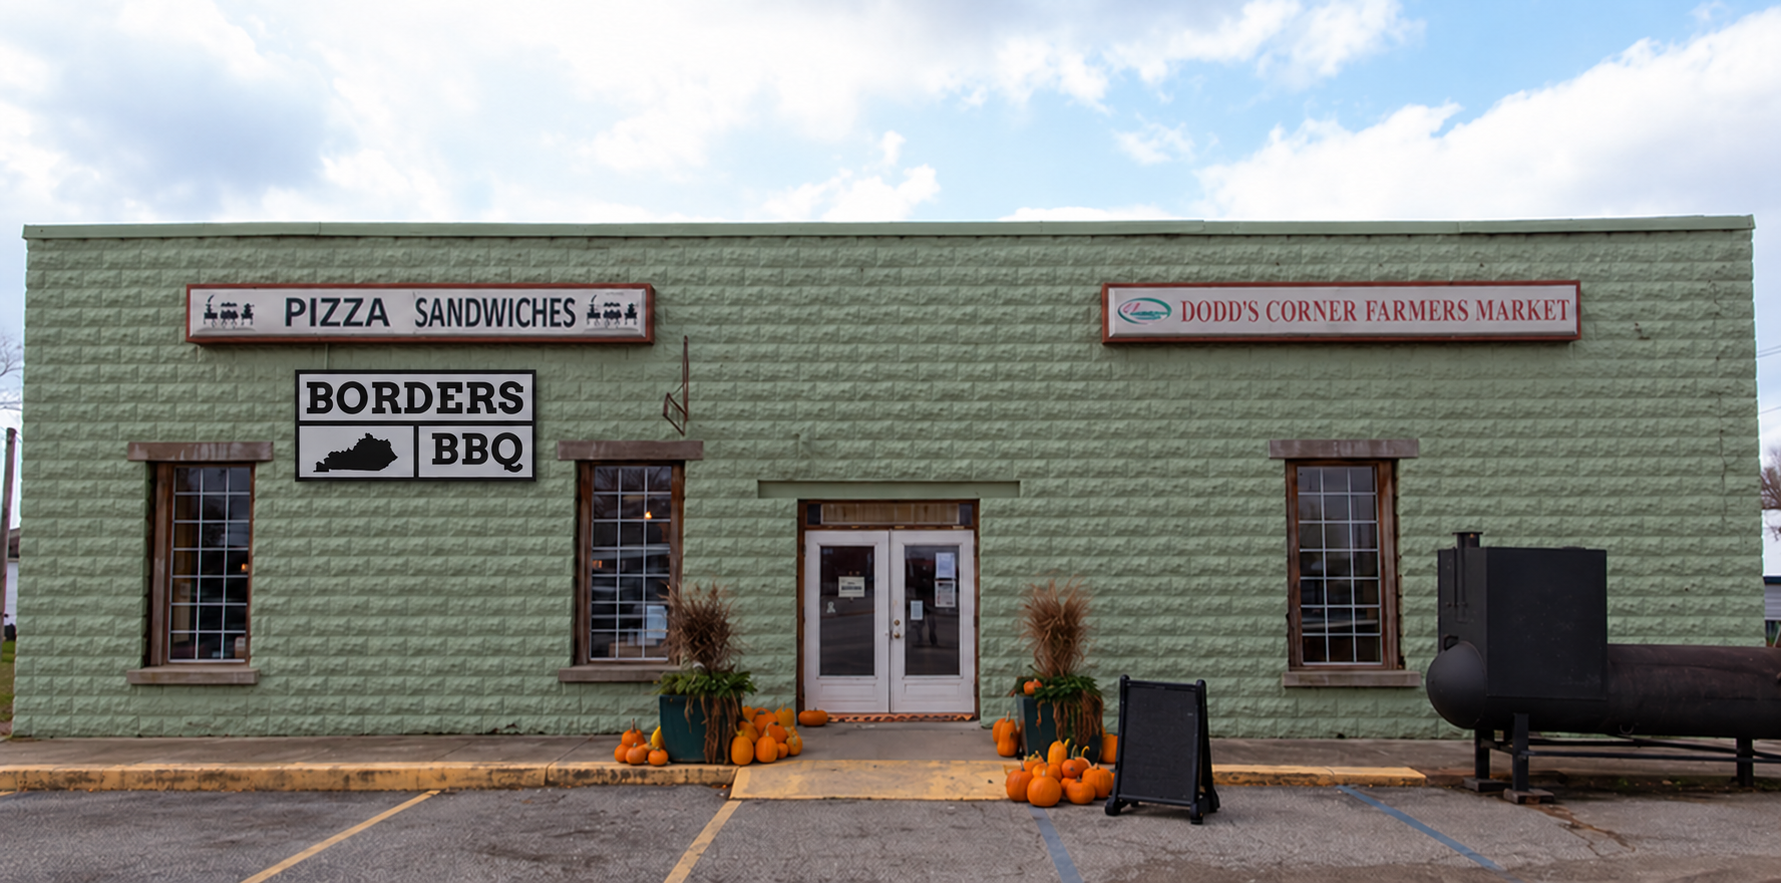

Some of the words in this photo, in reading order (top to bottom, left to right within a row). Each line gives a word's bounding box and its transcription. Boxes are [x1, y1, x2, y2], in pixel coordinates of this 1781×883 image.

[285, 297, 391, 327] PIZZA
[414, 297, 576, 328] SANDWICHES
[1181, 300, 1259, 322] DODD'S
[1266, 300, 1357, 322] CORNER
[1365, 299, 1469, 322] FARMERS
[1476, 299, 1570, 321] MARKET
[306, 381, 524, 415] BORDERS
[431, 432, 523, 473] BBQ
